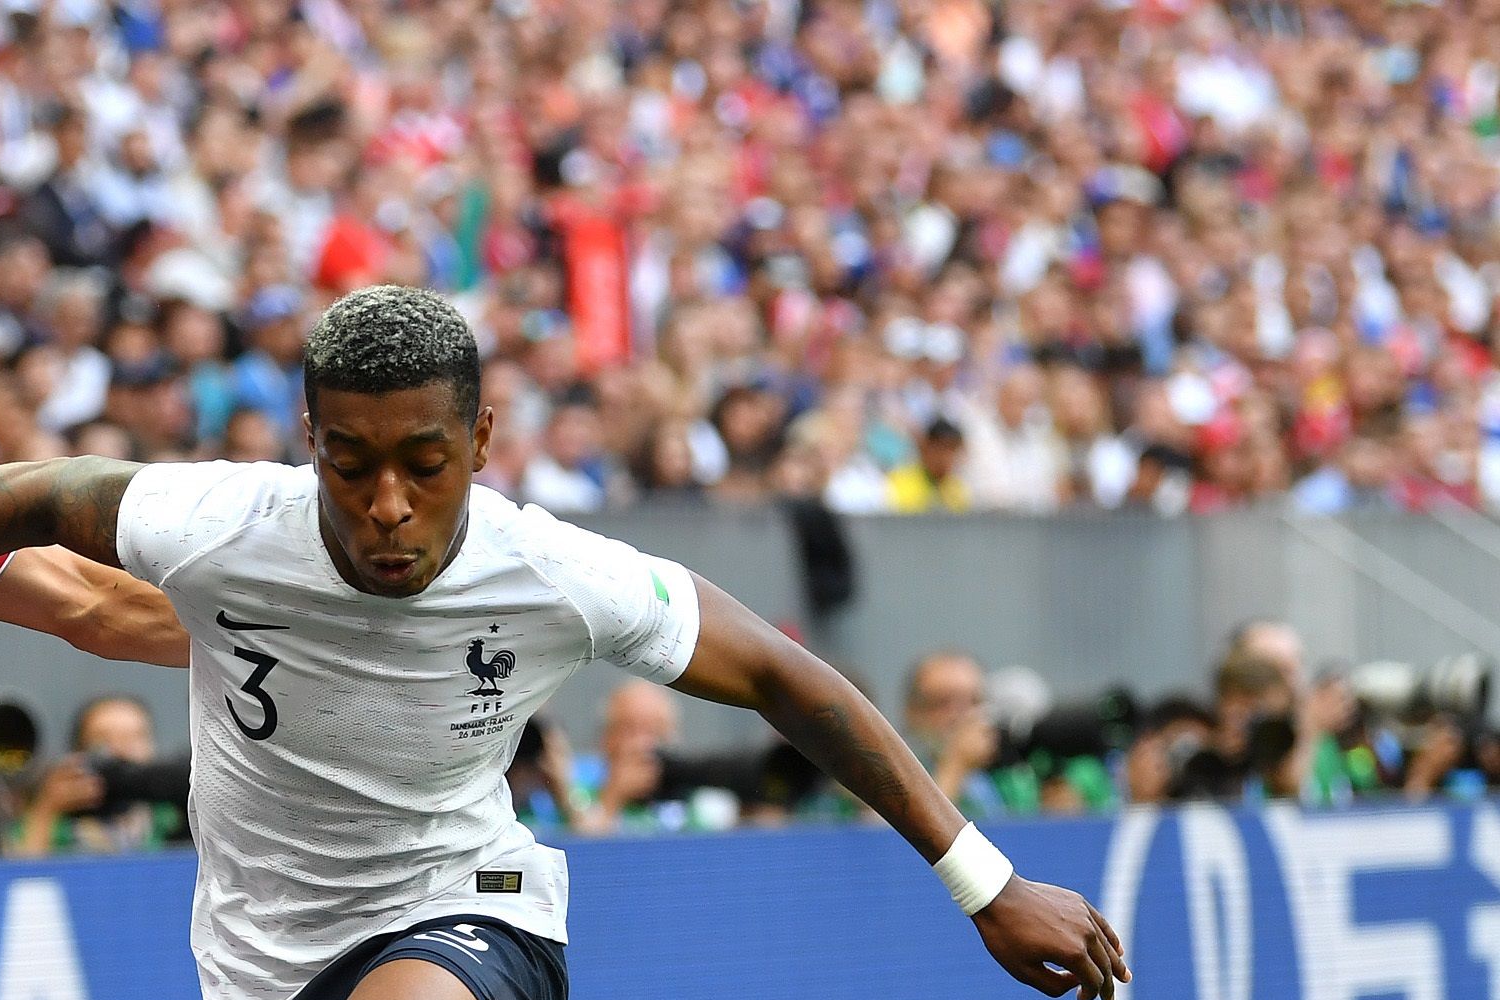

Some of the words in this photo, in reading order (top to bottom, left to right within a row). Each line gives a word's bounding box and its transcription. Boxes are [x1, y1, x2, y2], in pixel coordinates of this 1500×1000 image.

[224, 645, 280, 741] 3
[458, 731, 469, 739] 26
[470, 728, 486, 738] JUIN
